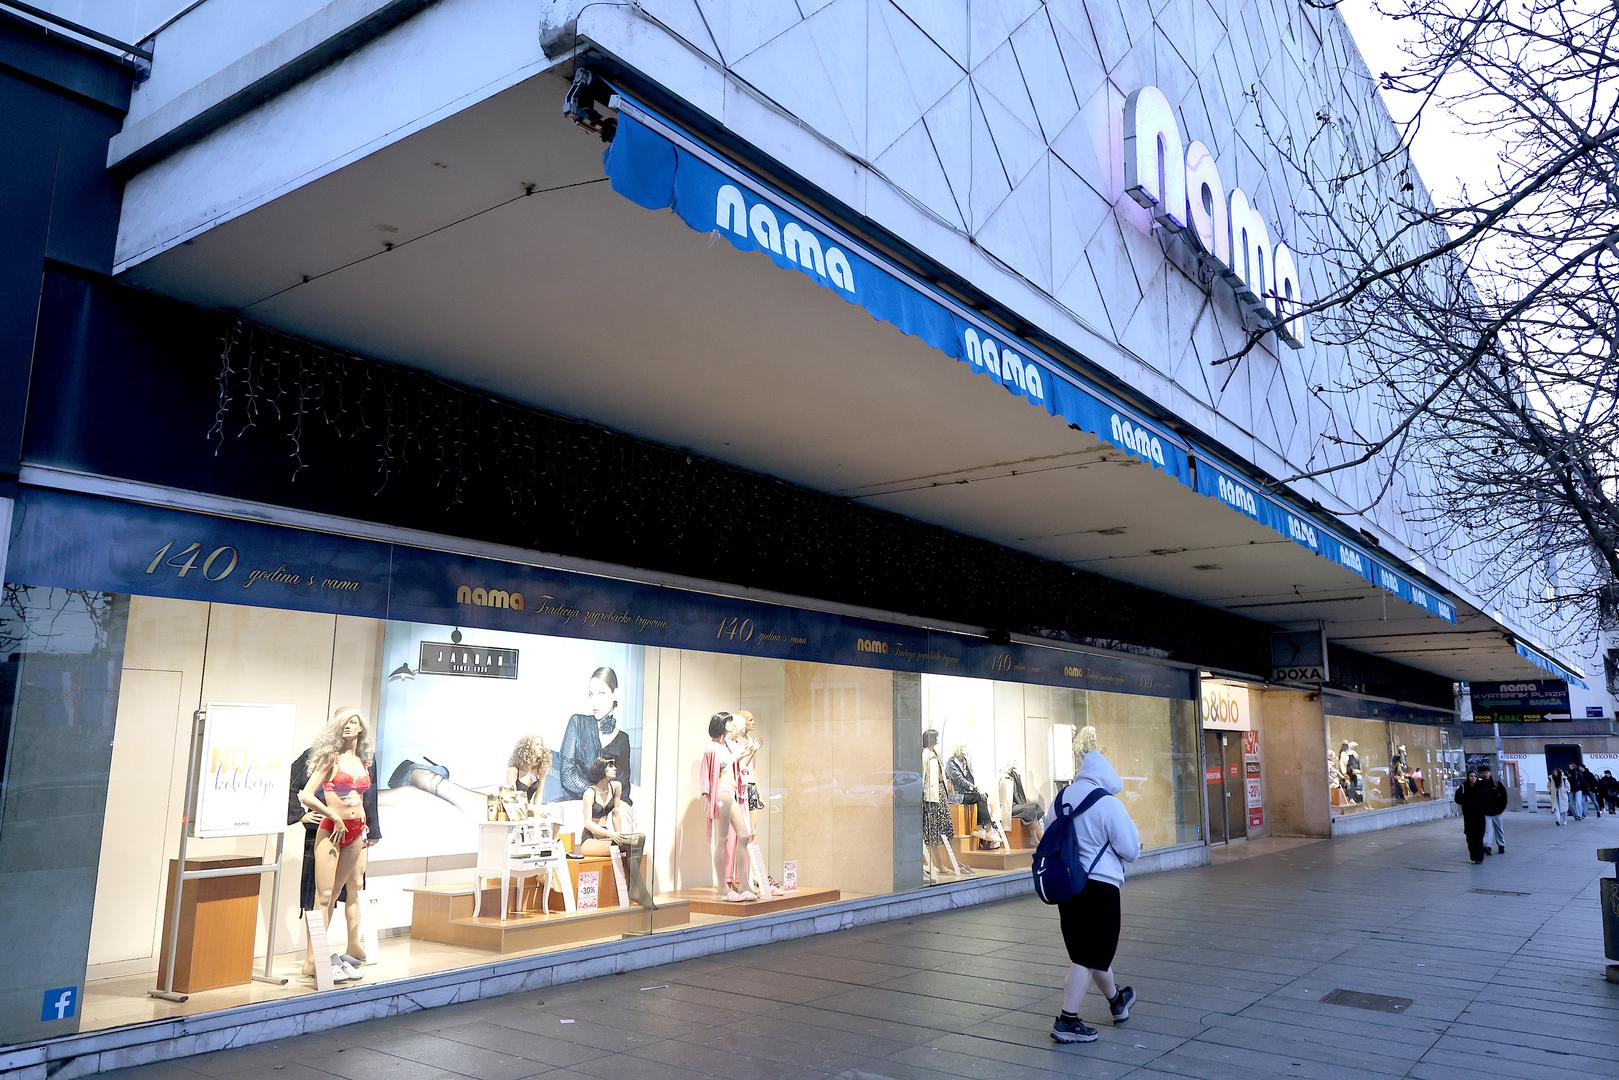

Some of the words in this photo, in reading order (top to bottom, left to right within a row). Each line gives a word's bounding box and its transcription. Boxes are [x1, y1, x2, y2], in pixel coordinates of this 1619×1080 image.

[1123, 85, 1304, 350] nama
[716, 184, 856, 293] nama
[965, 328, 1043, 399] nama
[1111, 414, 1165, 465] nama
[1218, 475, 1257, 515] nama
[1288, 515, 1318, 547] nama
[146, 539, 239, 581] 140
[243, 564, 300, 588] godina
[308, 576, 315, 586] s
[321, 579, 361, 592] vama
[456, 584, 526, 611] nama
[716, 616, 755, 642] 140
[857, 638, 889, 655] nama
[992, 654, 1011, 672] 140
[1064, 665, 1083, 678] nama
[1276, 668, 1322, 681] DOXA
[1500, 683, 1537, 692] nama
[581, 886, 596, 894] -30%
